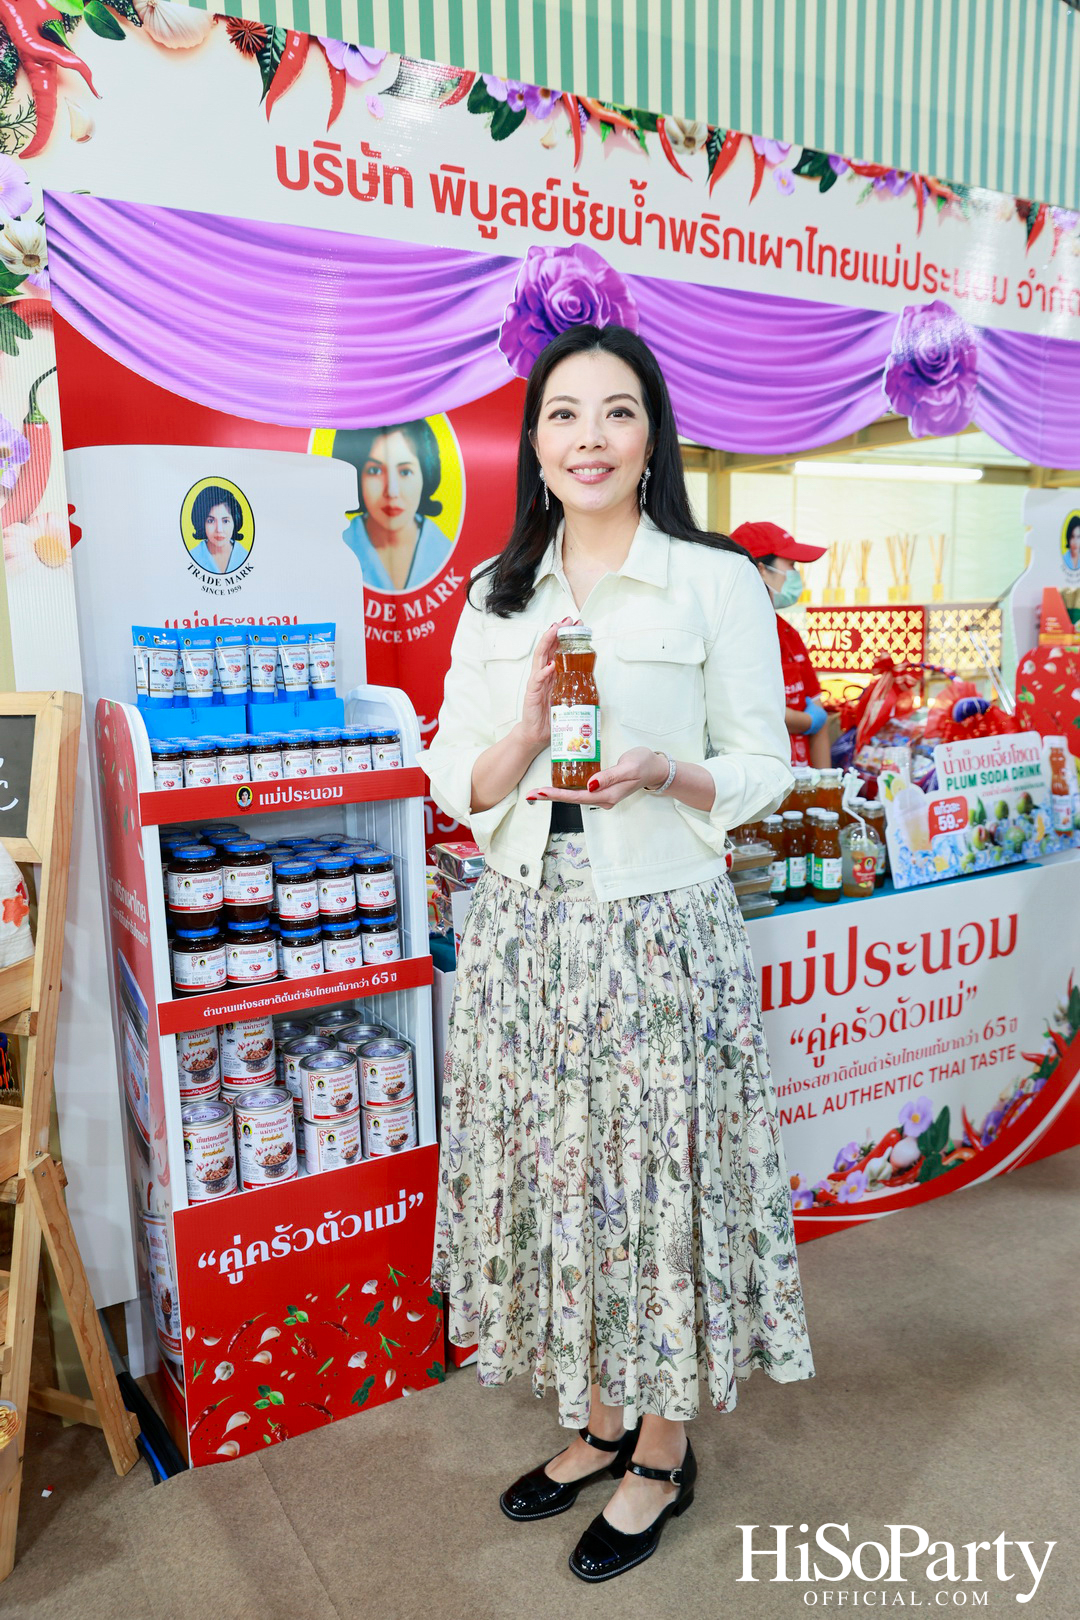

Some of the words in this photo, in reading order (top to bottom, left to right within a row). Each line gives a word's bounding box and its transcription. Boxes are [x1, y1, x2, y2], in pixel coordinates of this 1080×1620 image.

[276, 140, 414, 208] บริษัท
[429, 164, 1009, 304] พิบูลย์ชัยน้ำพริกเผาไทยแม่ประนอม
[187, 562, 221, 586] TRADE
[225, 563, 254, 586] MARK
[201, 585, 225, 596] SINCE
[228, 585, 242, 595] 1959
[403, 567, 464, 621] MARK
[365, 624, 403, 643] INCE
[406, 620, 435, 642] 1959
[259, 786, 343, 806] แม่ประนอม
[947, 774, 976, 791] PLUM
[980, 769, 1008, 785] SODA
[1012, 763, 1042, 780] DRINK
[372, 972, 389, 986] 65
[391, 973, 397, 982] ปี
[762, 913, 1019, 1012] แม่ประนอม
[774, 1029, 979, 1098] แห่งรสชาติต้นตำรับไทยแท้มากว่า
[983, 1016, 1007, 1040] 65
[1009, 1017, 1018, 1033] ปี
[823, 1071, 924, 1115] AUTHENTIC
[929, 1059, 966, 1083] THAI
[970, 1044, 1017, 1071] TASTE
[198, 1188, 424, 1285] “คู่ครัวตัวแม่”
